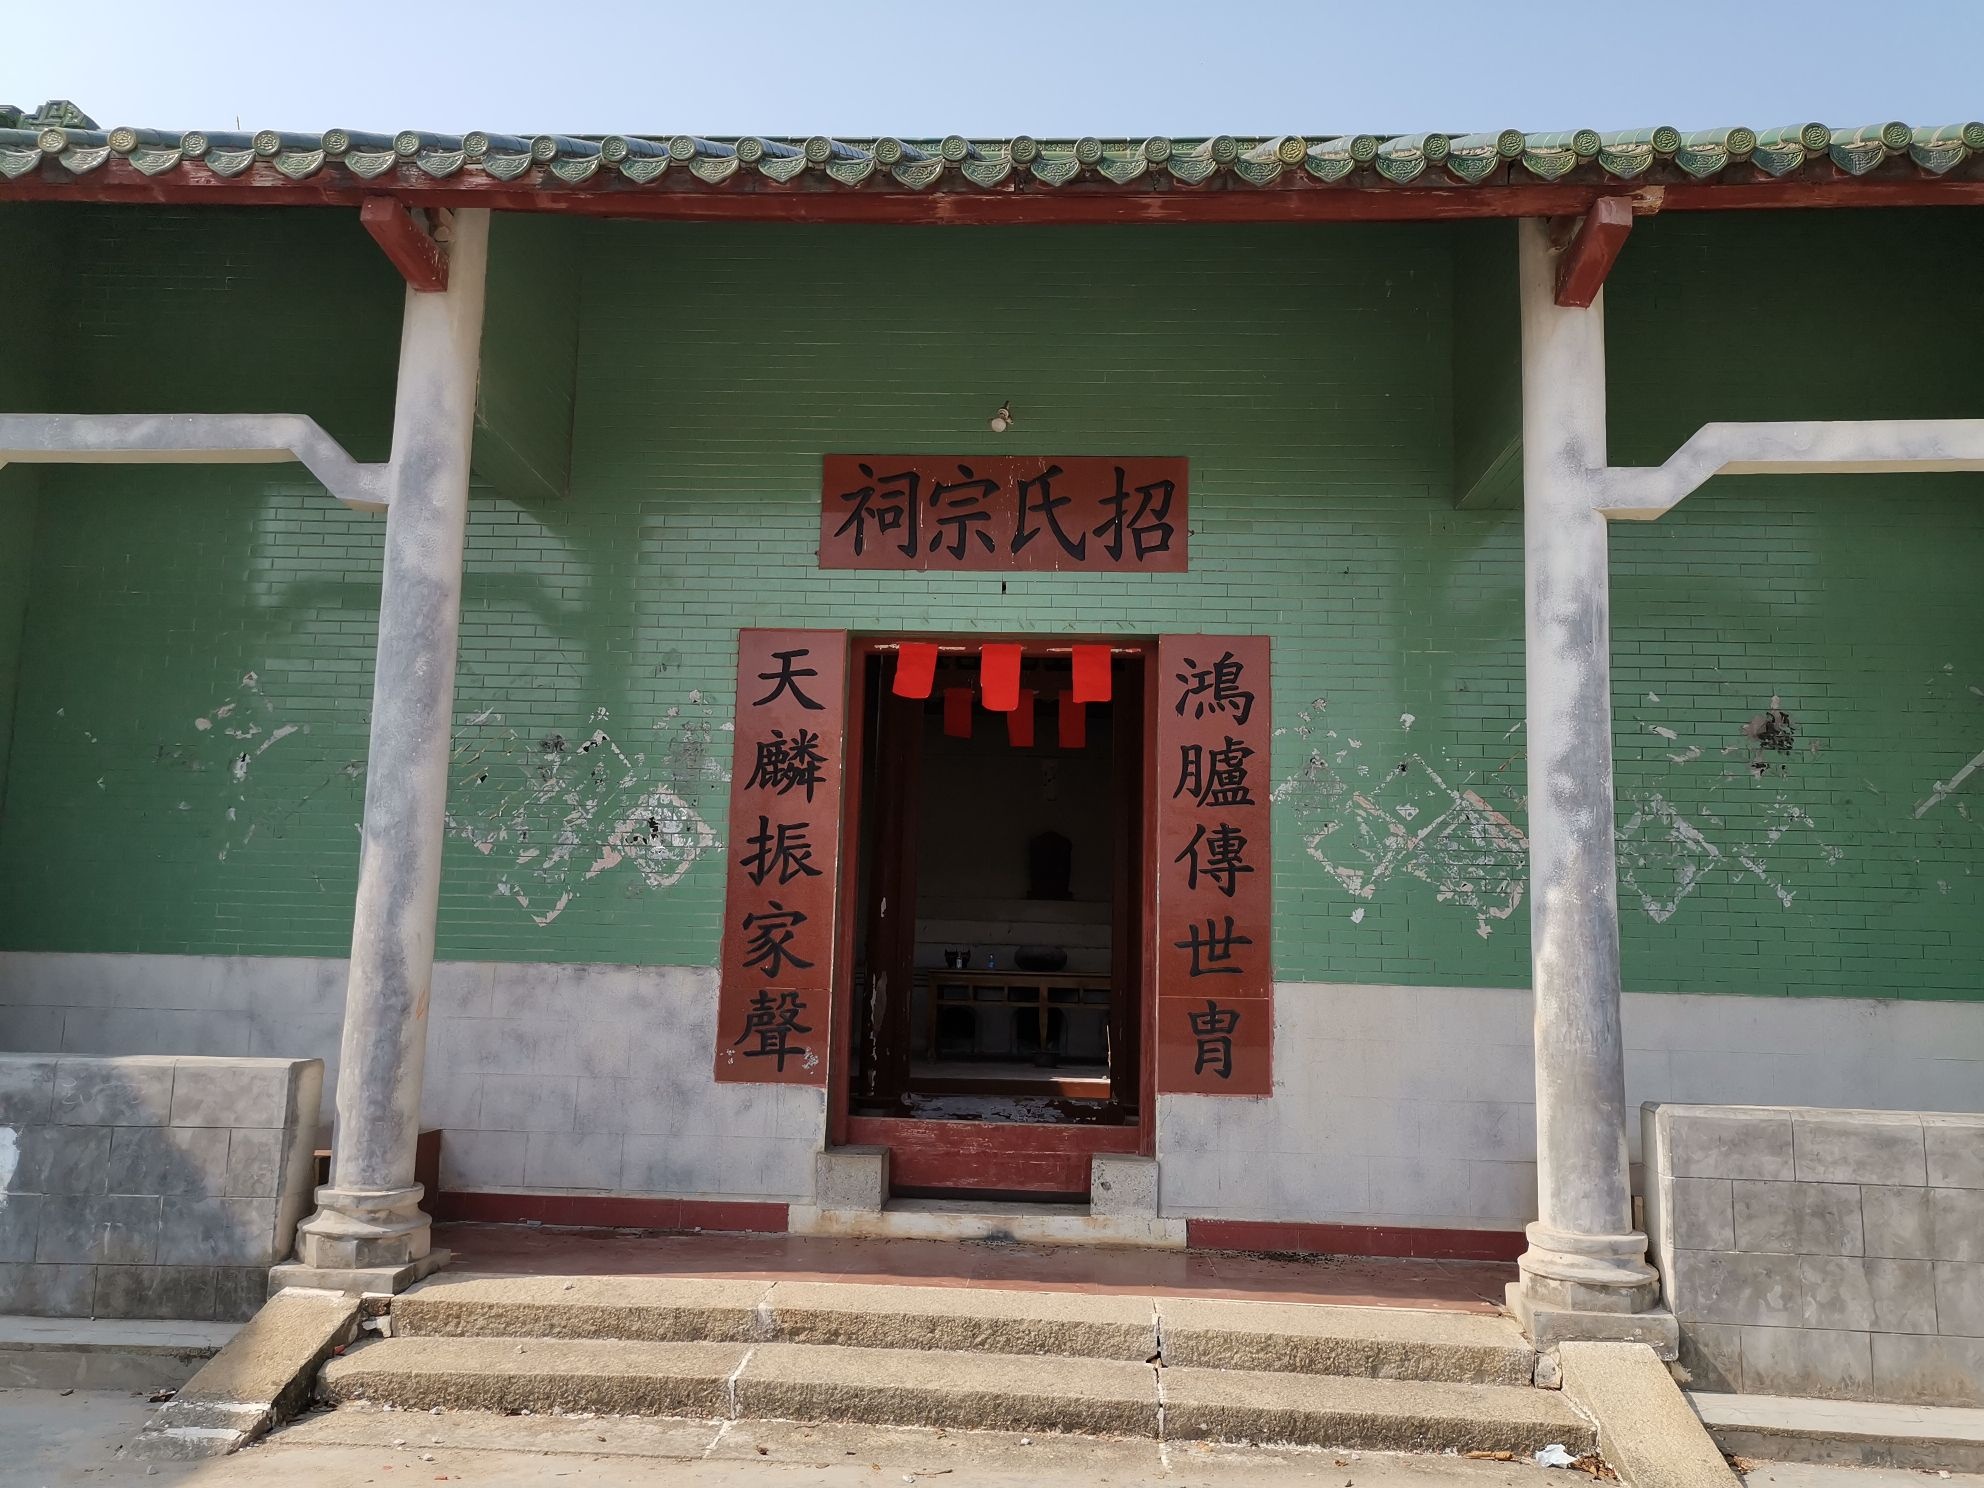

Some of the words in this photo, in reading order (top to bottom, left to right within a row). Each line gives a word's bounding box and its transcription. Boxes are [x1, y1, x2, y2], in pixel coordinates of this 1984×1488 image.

[834, 463, 1175, 562] 招氏宗祠
[734, 648, 827, 1073] 天麟振家聲
[1173, 651, 1255, 1079] 鴻臚傳世胄
